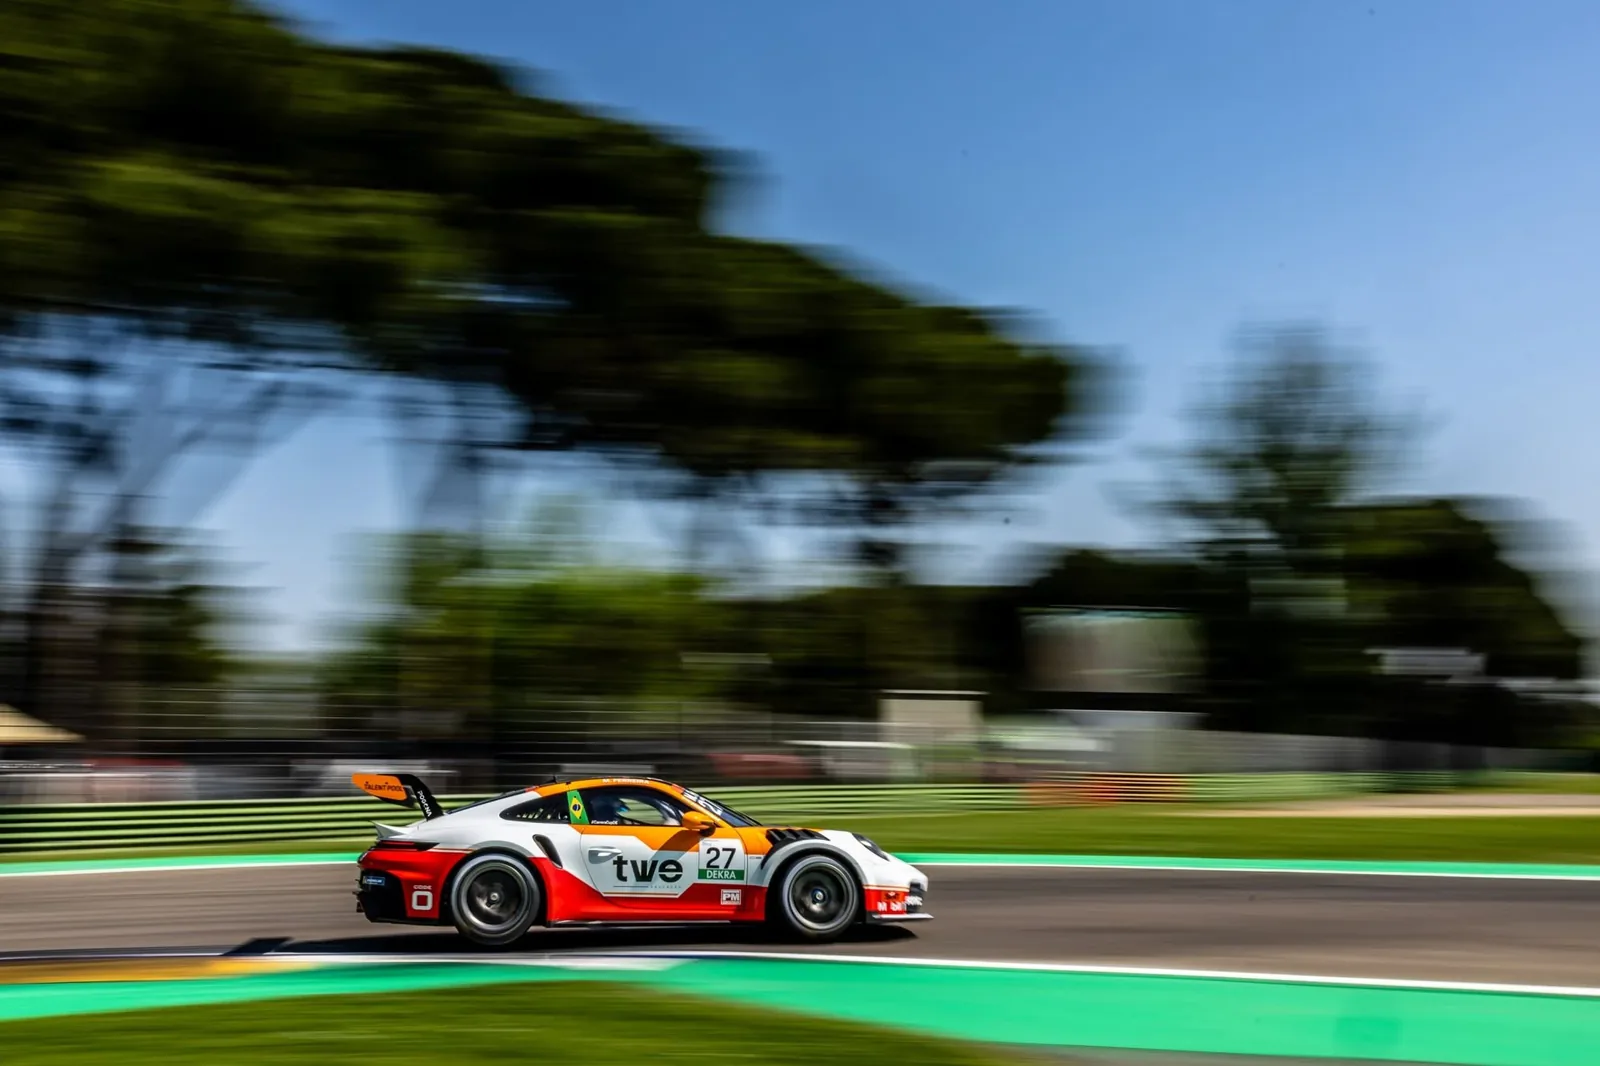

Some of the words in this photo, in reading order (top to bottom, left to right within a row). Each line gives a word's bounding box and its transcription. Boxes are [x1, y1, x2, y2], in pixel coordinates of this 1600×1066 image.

[364, 783, 386, 791] TALENT
[706, 847, 736, 869] 27
[613, 856, 683, 883] twe
[706, 870, 736, 879] DEKRA
[722, 893, 740, 902] PM
